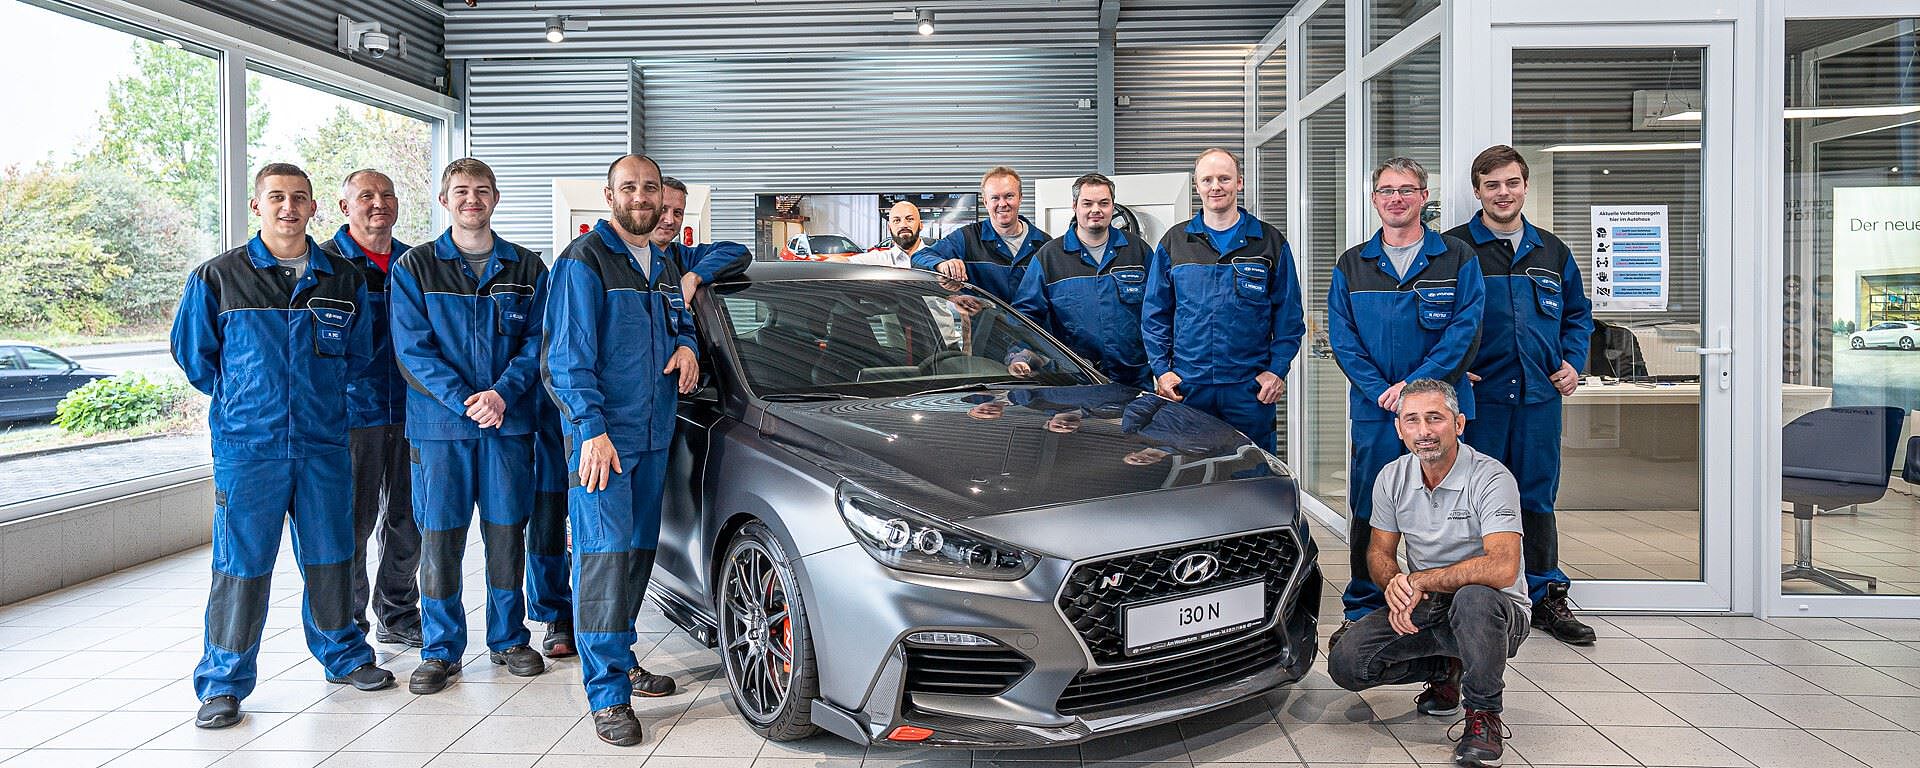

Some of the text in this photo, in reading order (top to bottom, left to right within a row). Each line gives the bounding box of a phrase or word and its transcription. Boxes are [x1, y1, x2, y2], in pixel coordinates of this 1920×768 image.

[1850, 218, 1920, 231] Der neue
[1179, 602, 1220, 626] i30 N
